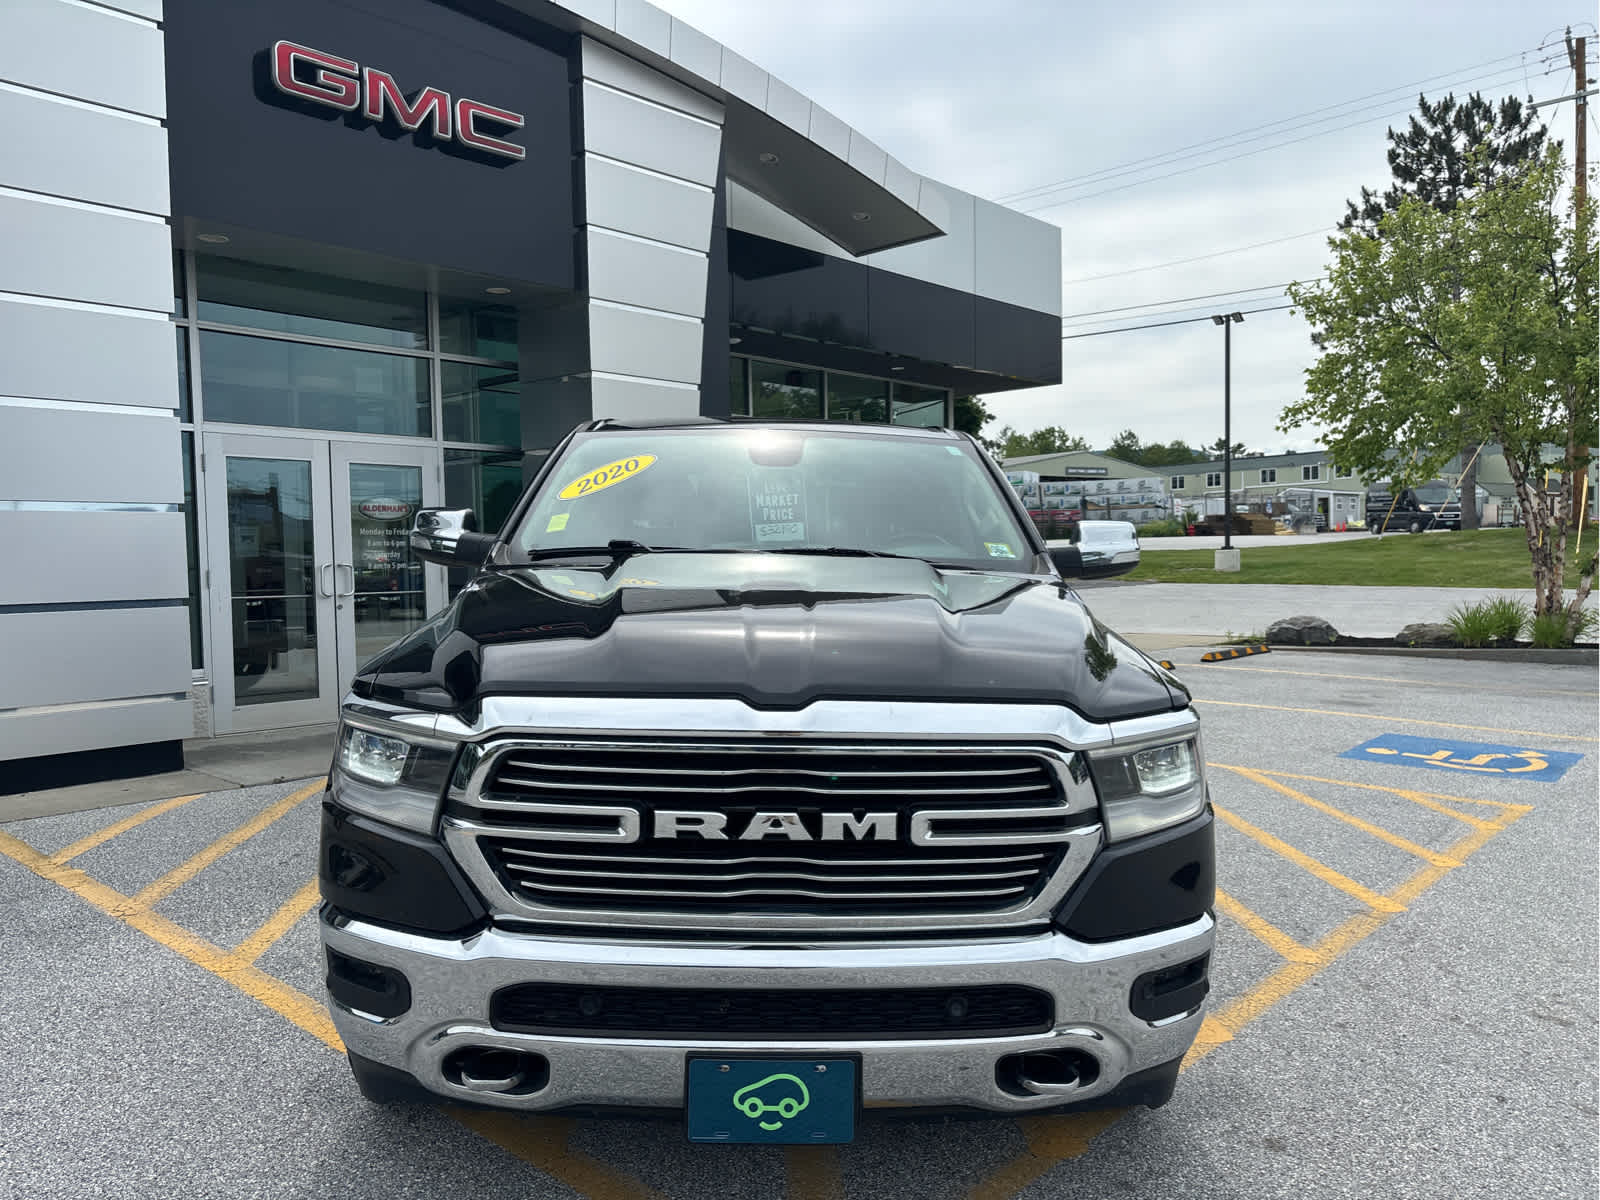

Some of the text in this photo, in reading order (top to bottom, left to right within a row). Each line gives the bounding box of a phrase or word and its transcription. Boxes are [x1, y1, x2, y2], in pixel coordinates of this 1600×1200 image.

[272, 40, 526, 160] GMC
[577, 459, 639, 495] 2020
[756, 493, 800, 509] MARKET
[763, 507, 793, 521] PRICE
[360, 527, 410, 537] Monday to Frida
[653, 810, 898, 841] RAM
